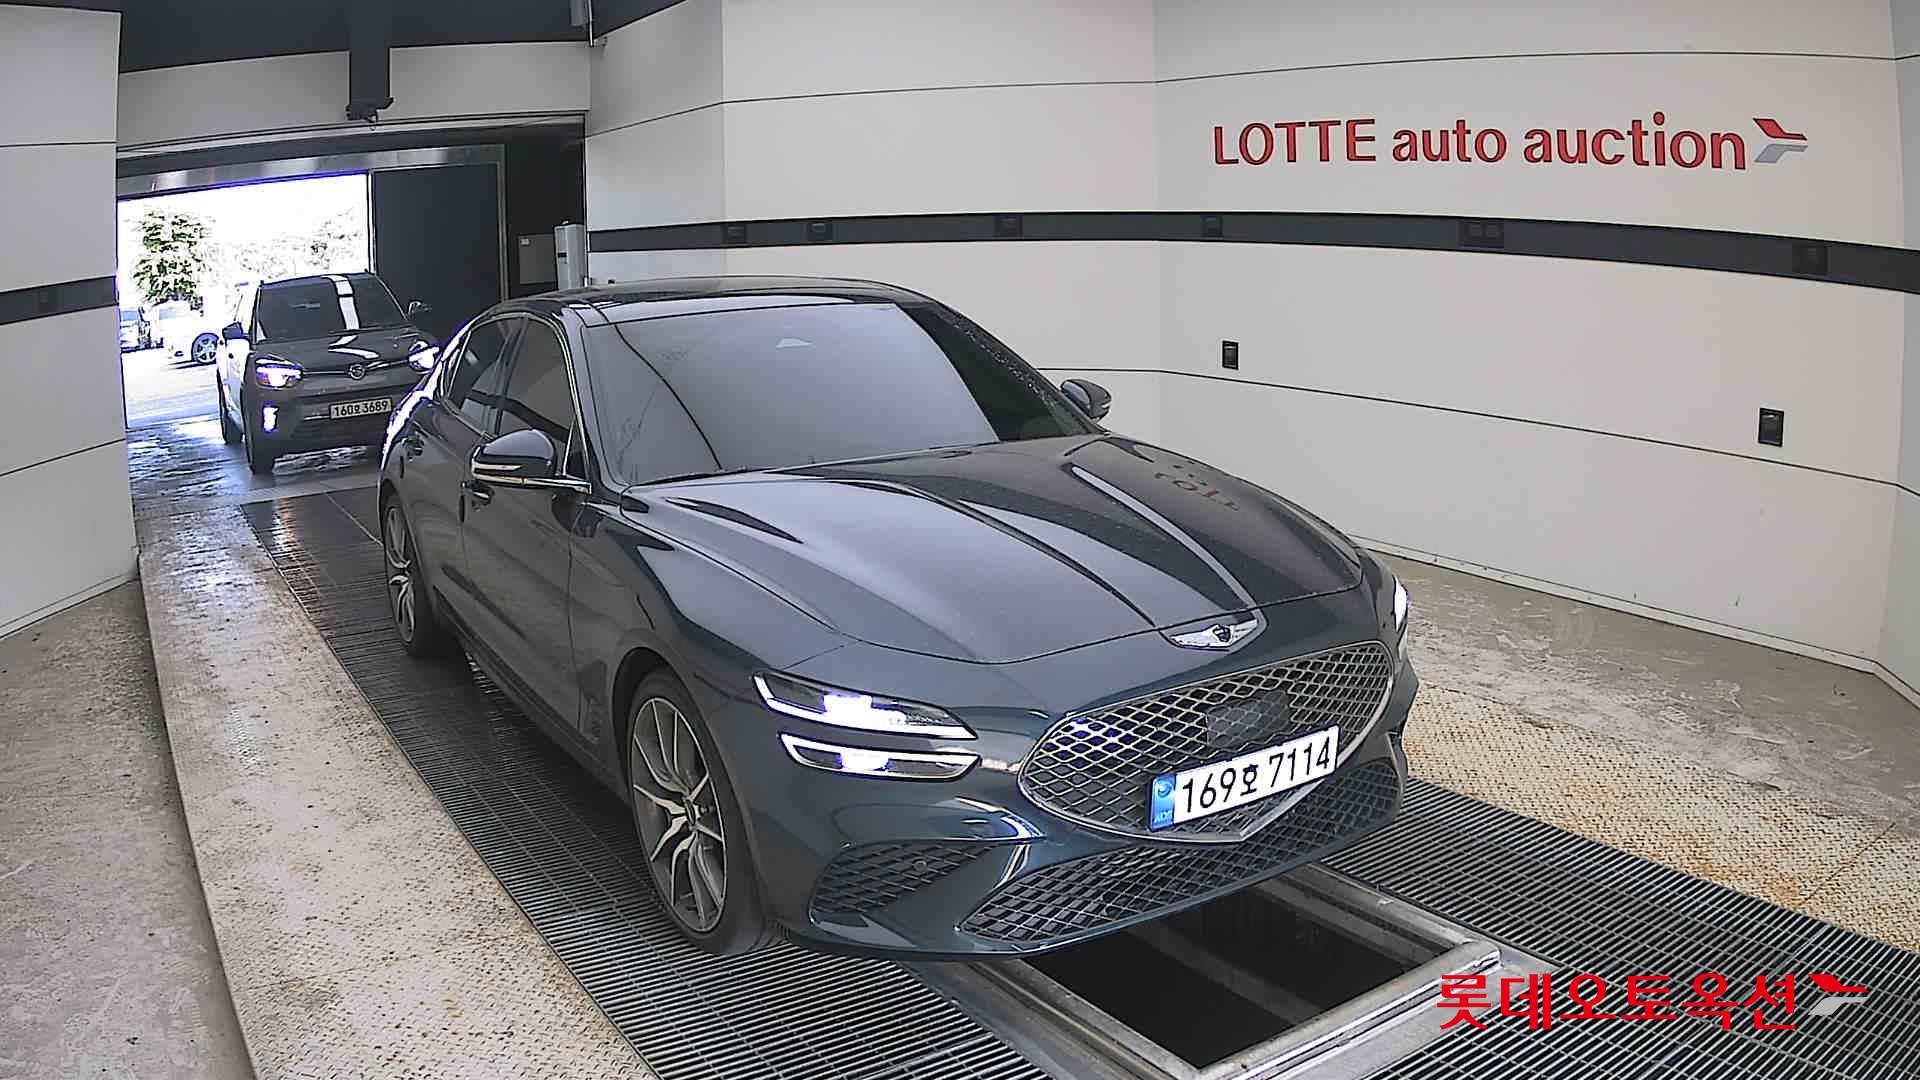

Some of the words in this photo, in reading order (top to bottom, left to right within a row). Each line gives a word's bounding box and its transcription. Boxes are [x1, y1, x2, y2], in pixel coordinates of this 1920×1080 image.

[1213, 118, 1376, 165] LOTTE
[1392, 119, 1507, 163] auto
[1523, 111, 1746, 170] auction
[362, 400, 388, 413] 3689
[1182, 763, 1259, 813] 169호
[1269, 736, 1330, 788] 7114
